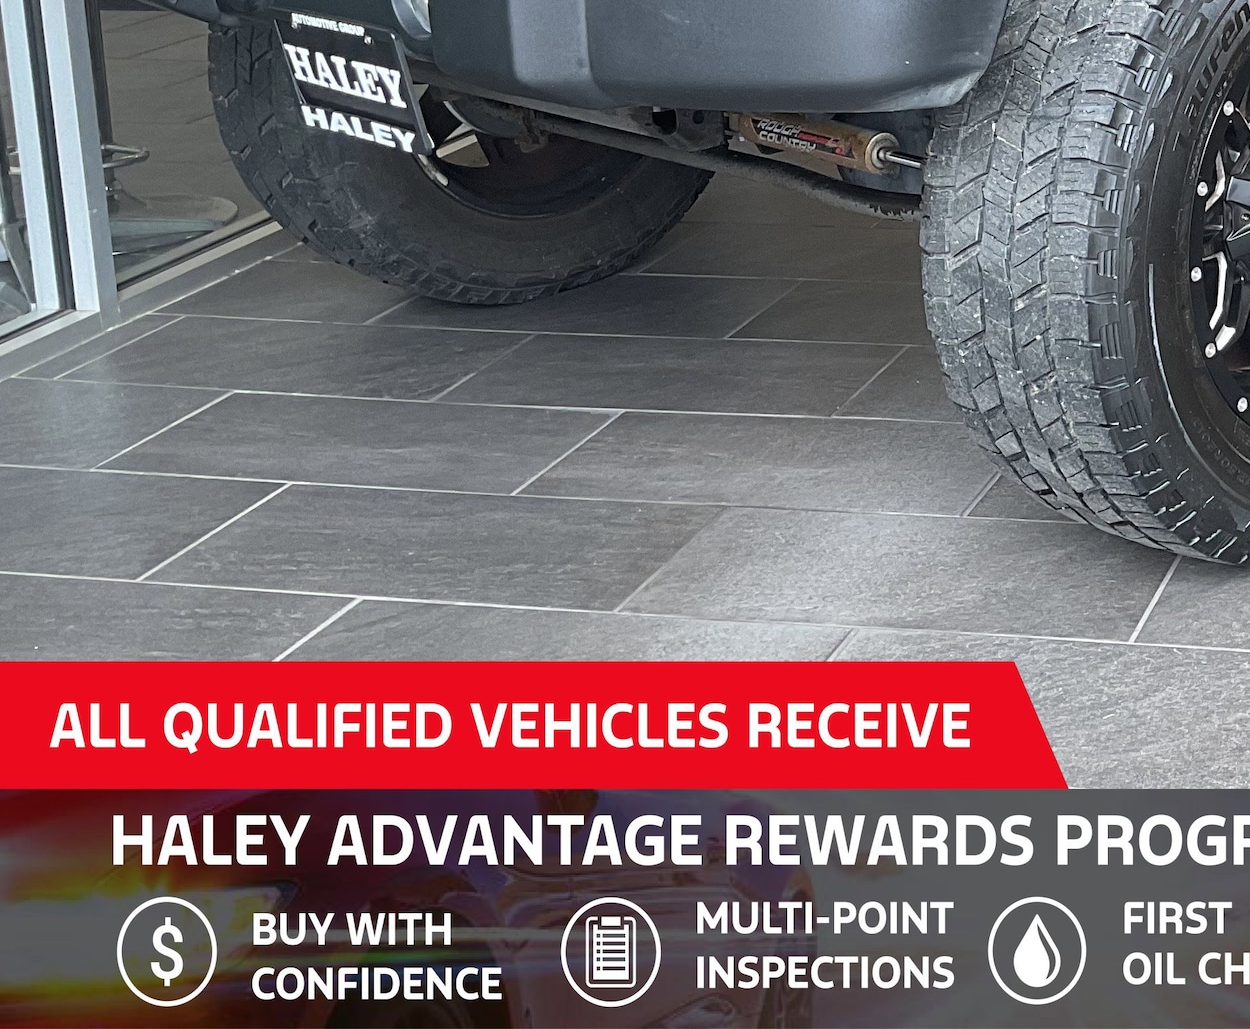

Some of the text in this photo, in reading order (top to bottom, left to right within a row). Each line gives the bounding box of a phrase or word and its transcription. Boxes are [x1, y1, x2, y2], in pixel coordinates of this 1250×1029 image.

[291, 12, 365, 37] AUTOMOTIVE GROUP
[283, 43, 408, 109] HALEY
[301, 104, 416, 153] HALEY
[757, 118, 801, 138] ROUGH
[759, 131, 817, 152] COUNTRY
